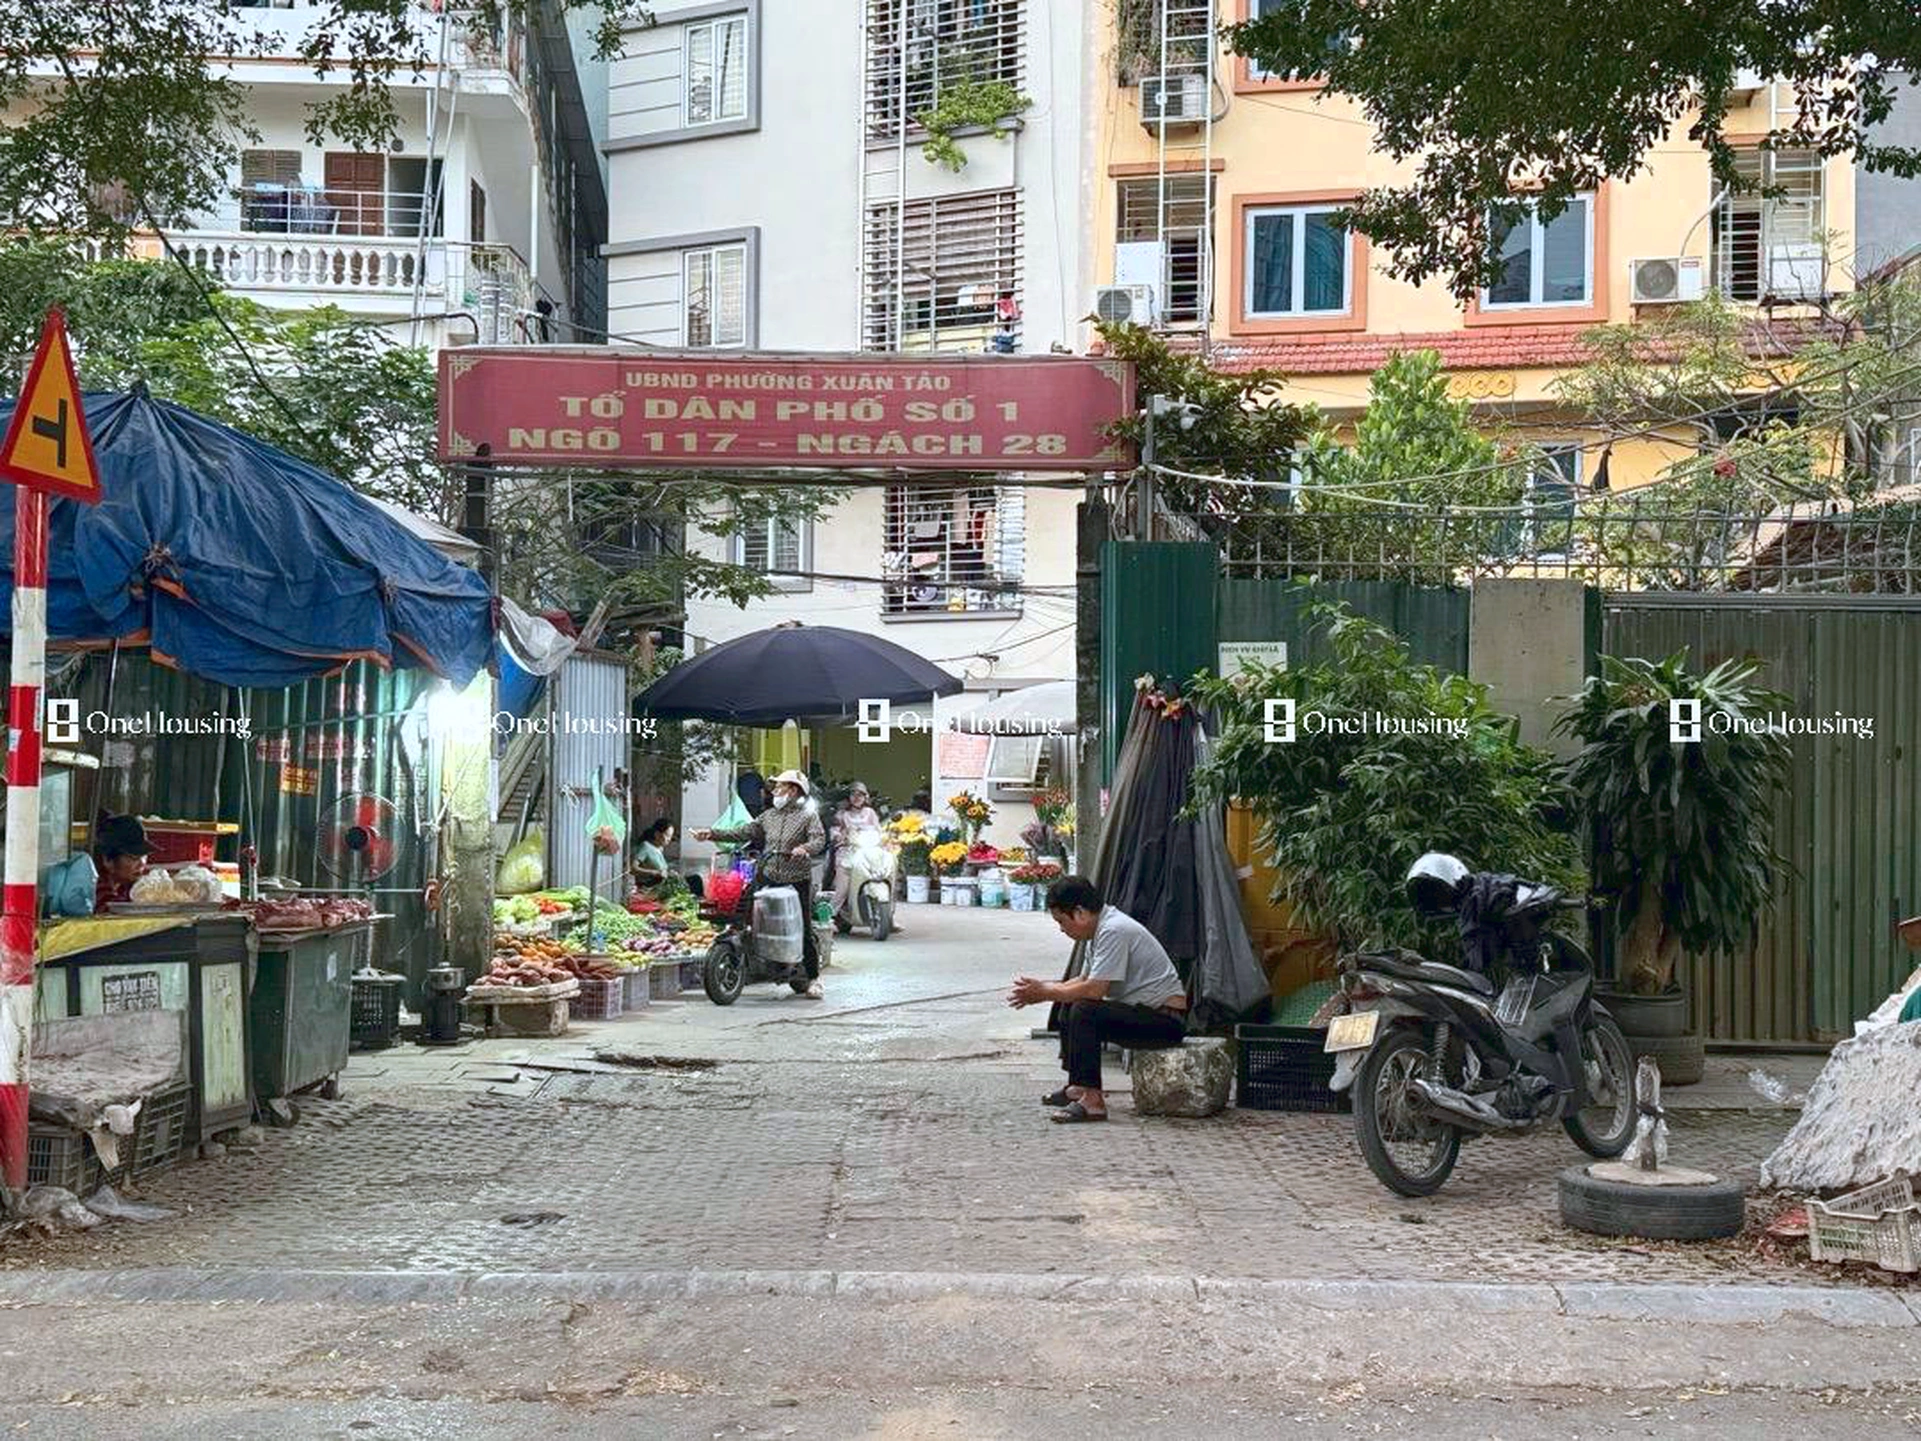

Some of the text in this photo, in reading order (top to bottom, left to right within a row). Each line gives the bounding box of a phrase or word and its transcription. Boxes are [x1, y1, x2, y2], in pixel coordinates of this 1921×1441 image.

[625, 371, 698, 389] UBND
[706, 370, 813, 390] PHƯỜNG
[822, 372, 894, 391] XUÂN
[644, 395, 756, 420] DÂN
[776, 394, 886, 422] PHỐ
[904, 394, 976, 422] SỐ
[996, 401, 1018, 422] 1
[508, 426, 621, 451] NGÕ
[642, 431, 739, 452] 117
[797, 430, 983, 455] NGÁCH
[1002, 434, 1067, 455] 28
